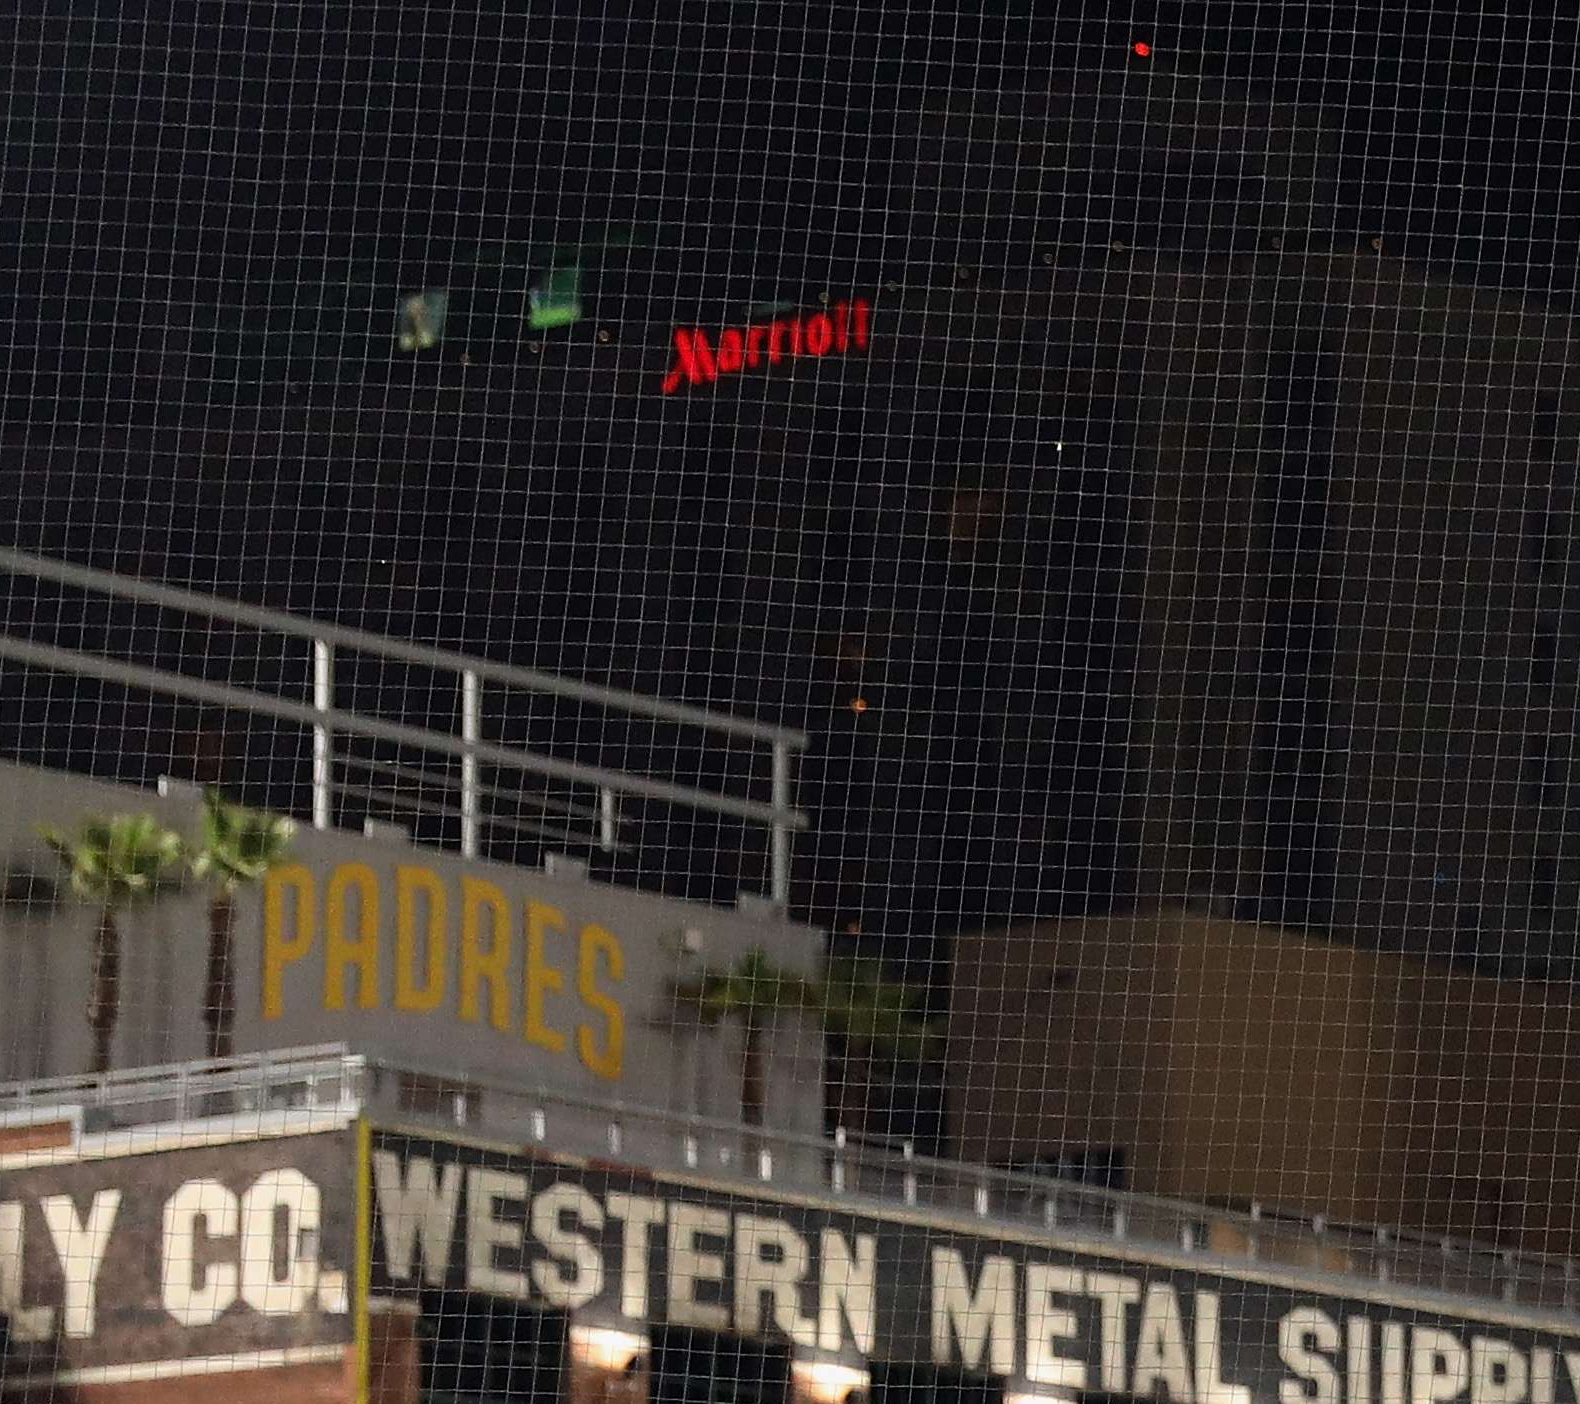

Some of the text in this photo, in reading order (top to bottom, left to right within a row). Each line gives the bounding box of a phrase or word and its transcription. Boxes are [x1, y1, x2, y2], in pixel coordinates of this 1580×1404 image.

[263, 862, 623, 1083] PADRES
[164, 1168, 349, 1327] CO.
[372, 1148, 878, 1353] WESTERN
